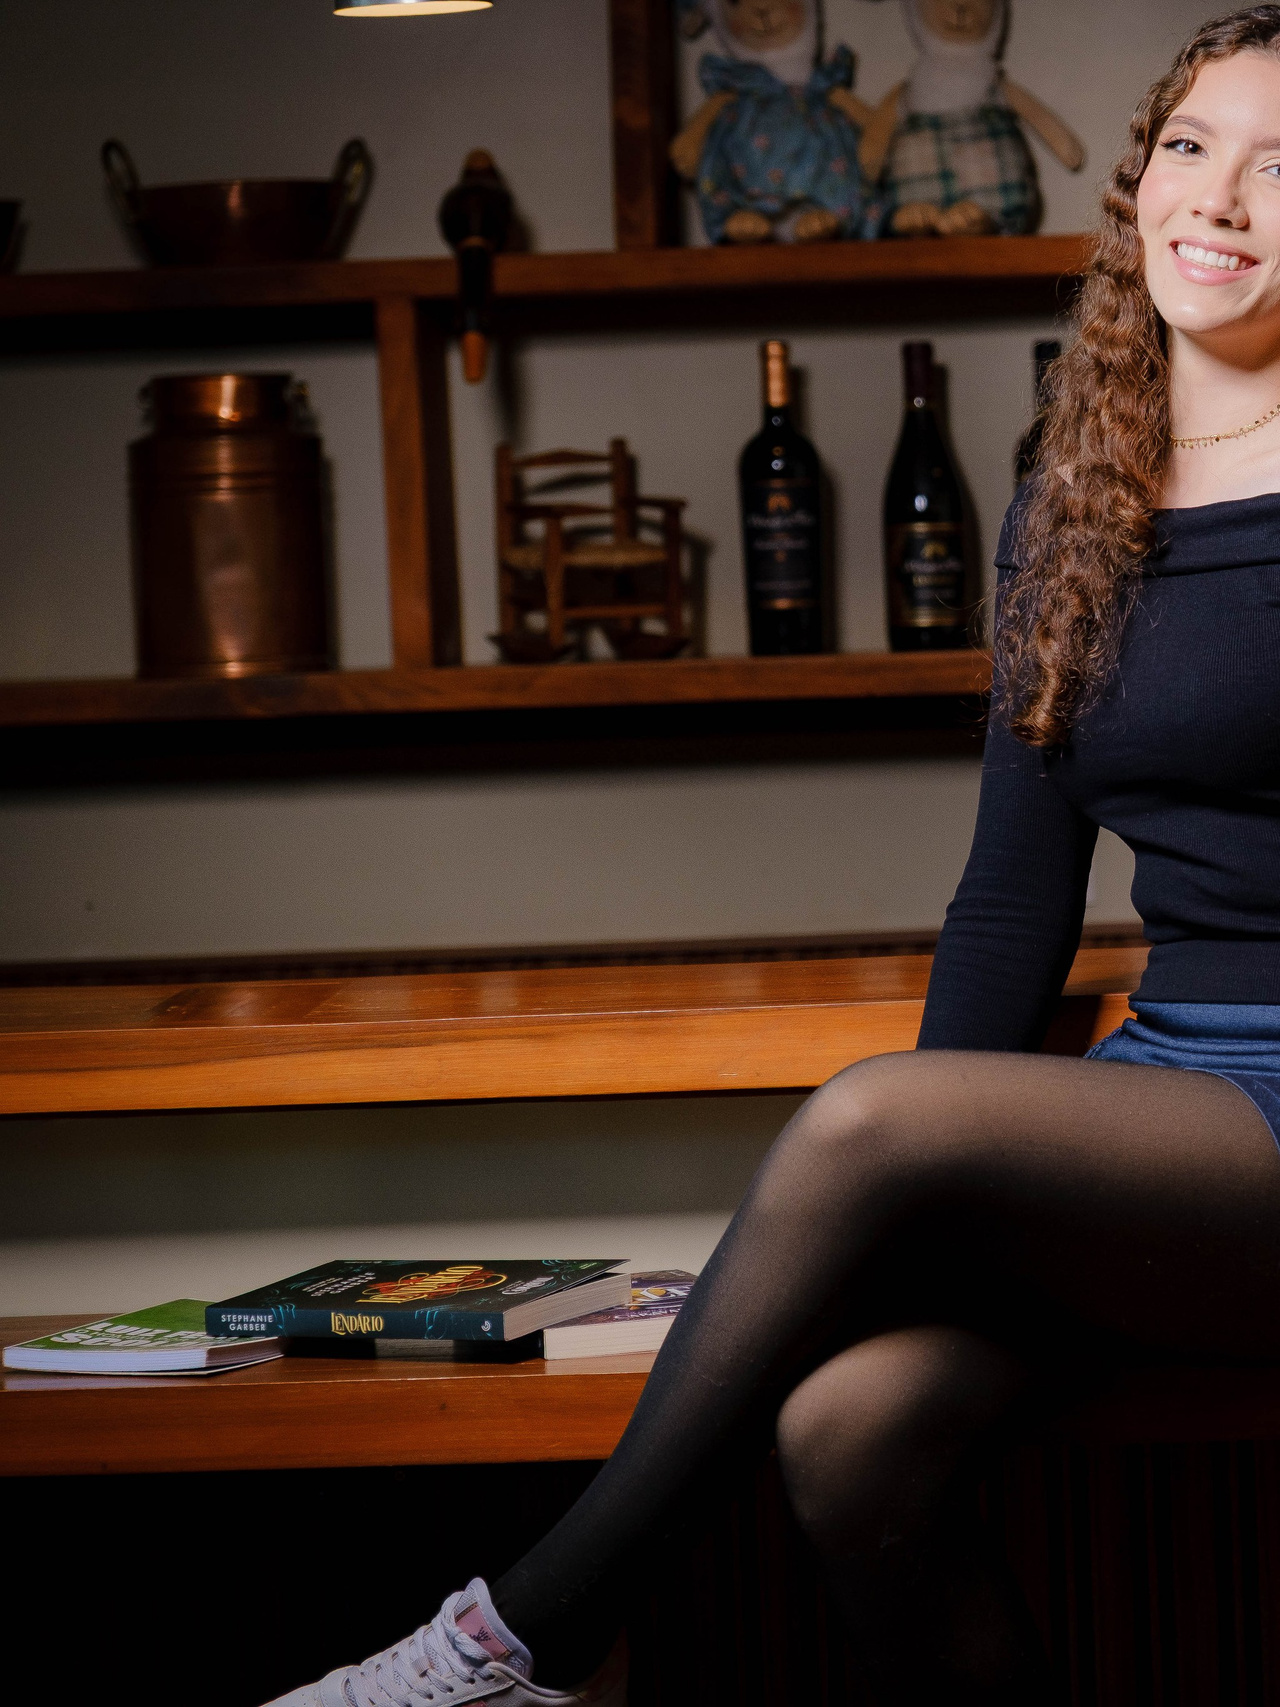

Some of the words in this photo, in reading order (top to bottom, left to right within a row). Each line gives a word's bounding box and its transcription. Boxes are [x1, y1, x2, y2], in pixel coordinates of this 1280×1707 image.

[221, 1314, 274, 1323] STEPHANIE
[229, 1323, 267, 1331] GARBER
[331, 1312, 384, 1335] LENDÁRIO
